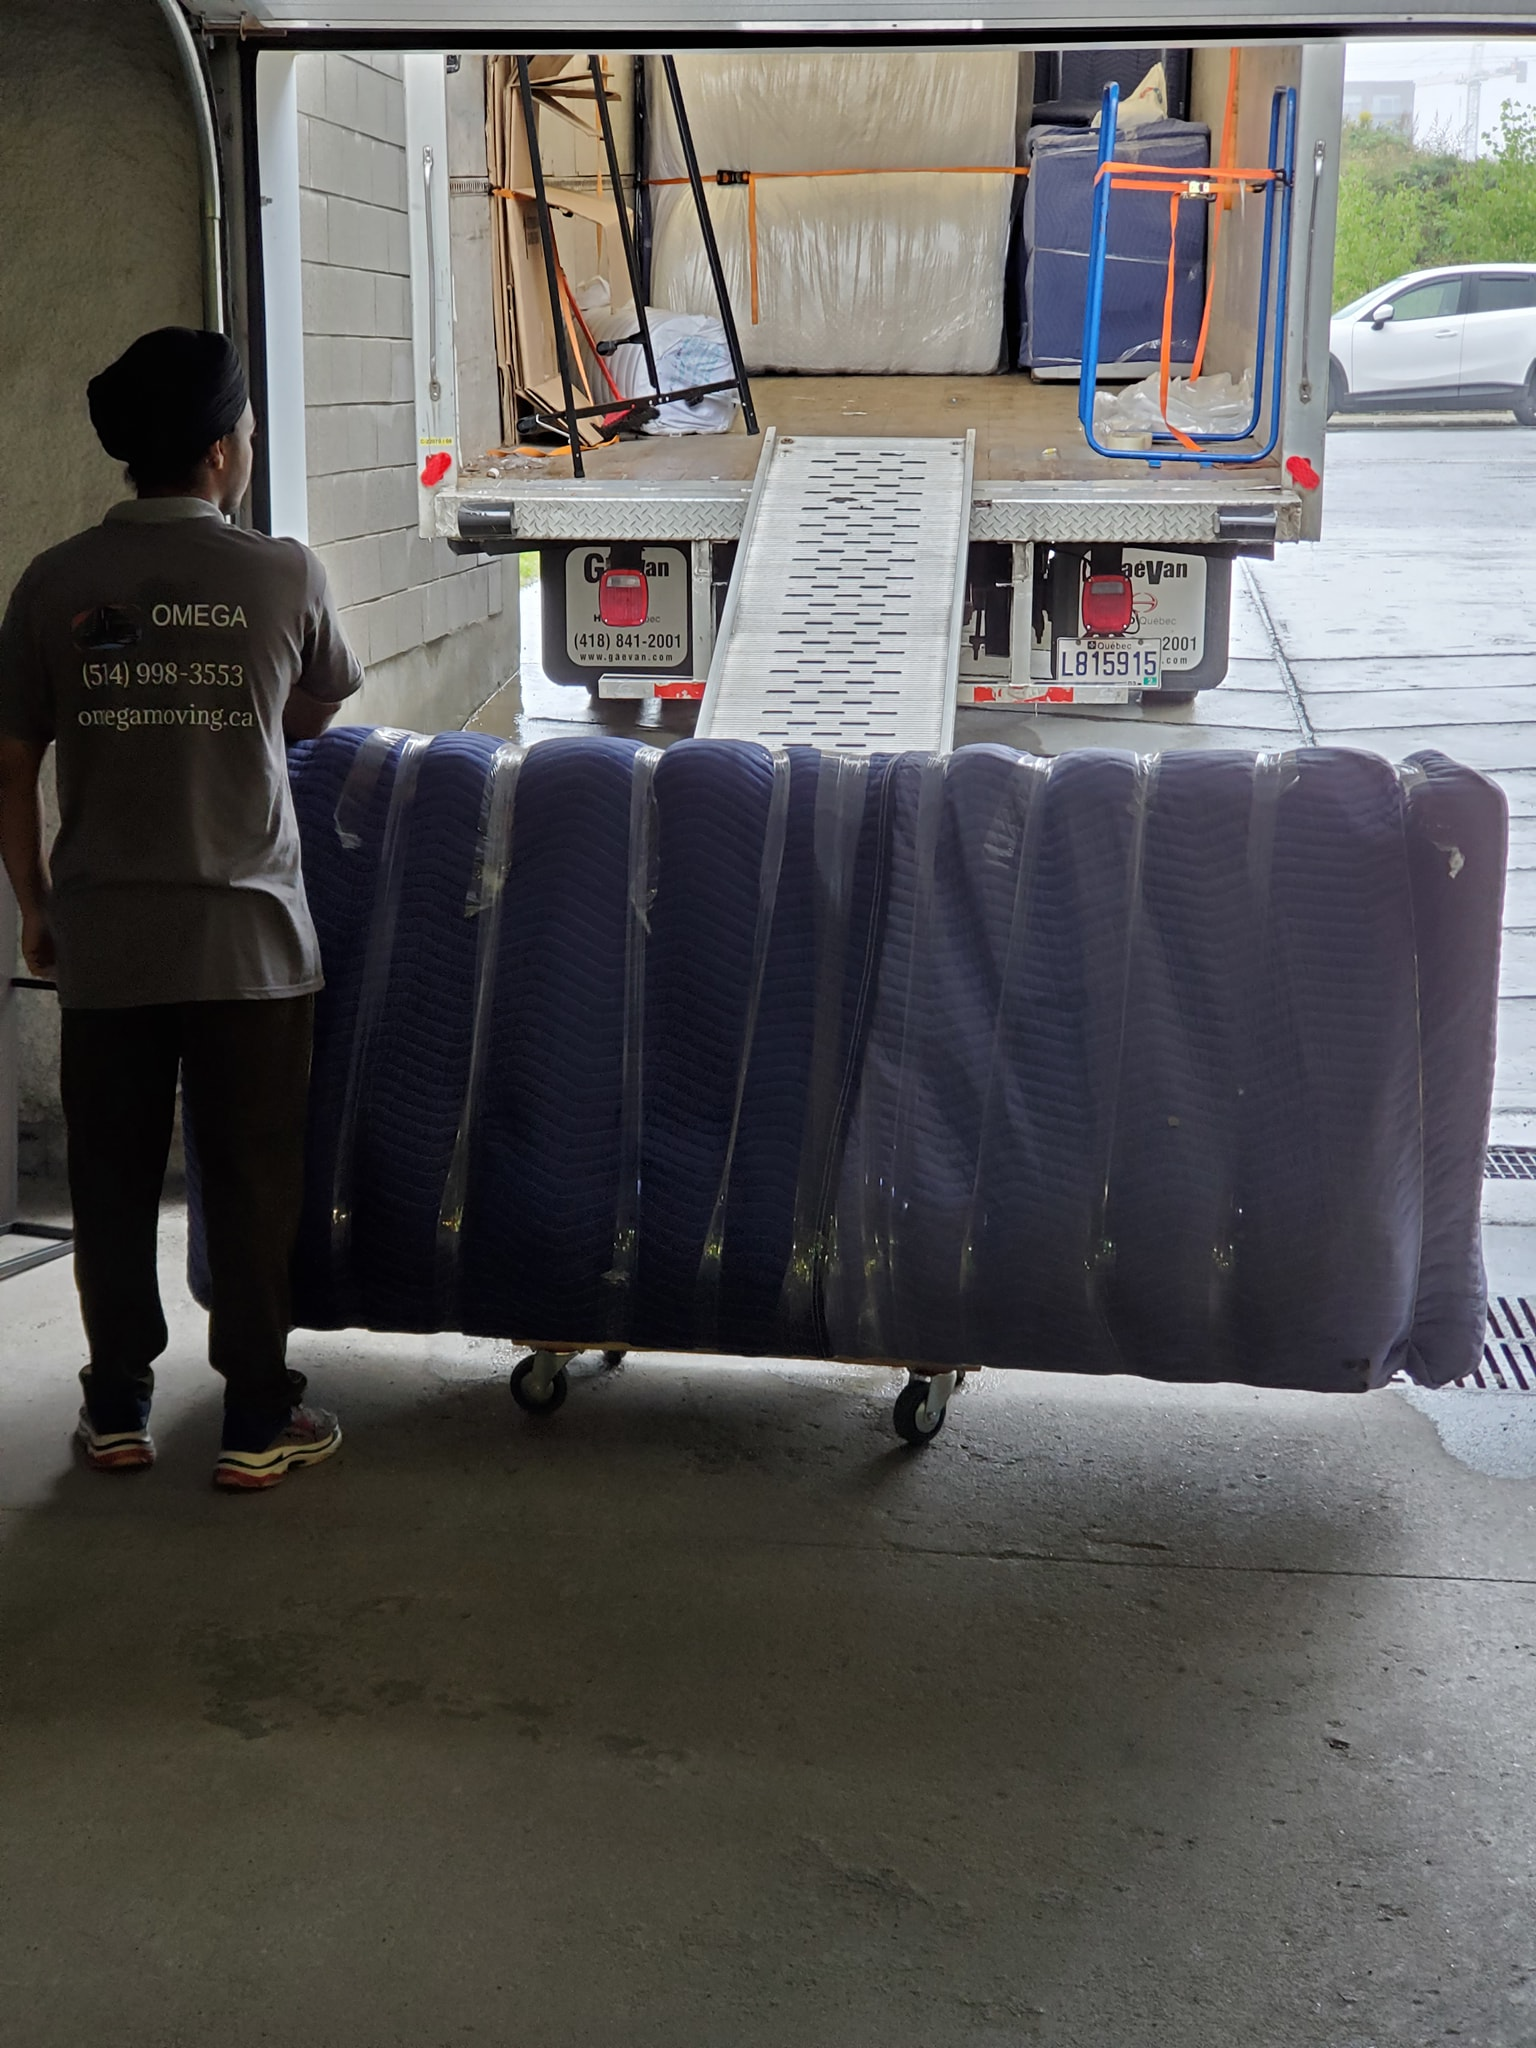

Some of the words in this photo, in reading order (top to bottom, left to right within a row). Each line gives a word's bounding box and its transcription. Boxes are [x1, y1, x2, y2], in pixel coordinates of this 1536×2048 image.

[151, 603, 248, 629] OMEGA
[574, 633, 610, 650] (418)
[616, 633, 681, 649] 841-2001
[1097, 641, 1132, 650] Québec
[1162, 636, 1196, 651] 2001
[579, 652, 673, 662] www.gaevan.com
[1061, 651, 1157, 676] L815915
[82, 661, 130, 690] (514)
[136, 662, 244, 687] 998-3553
